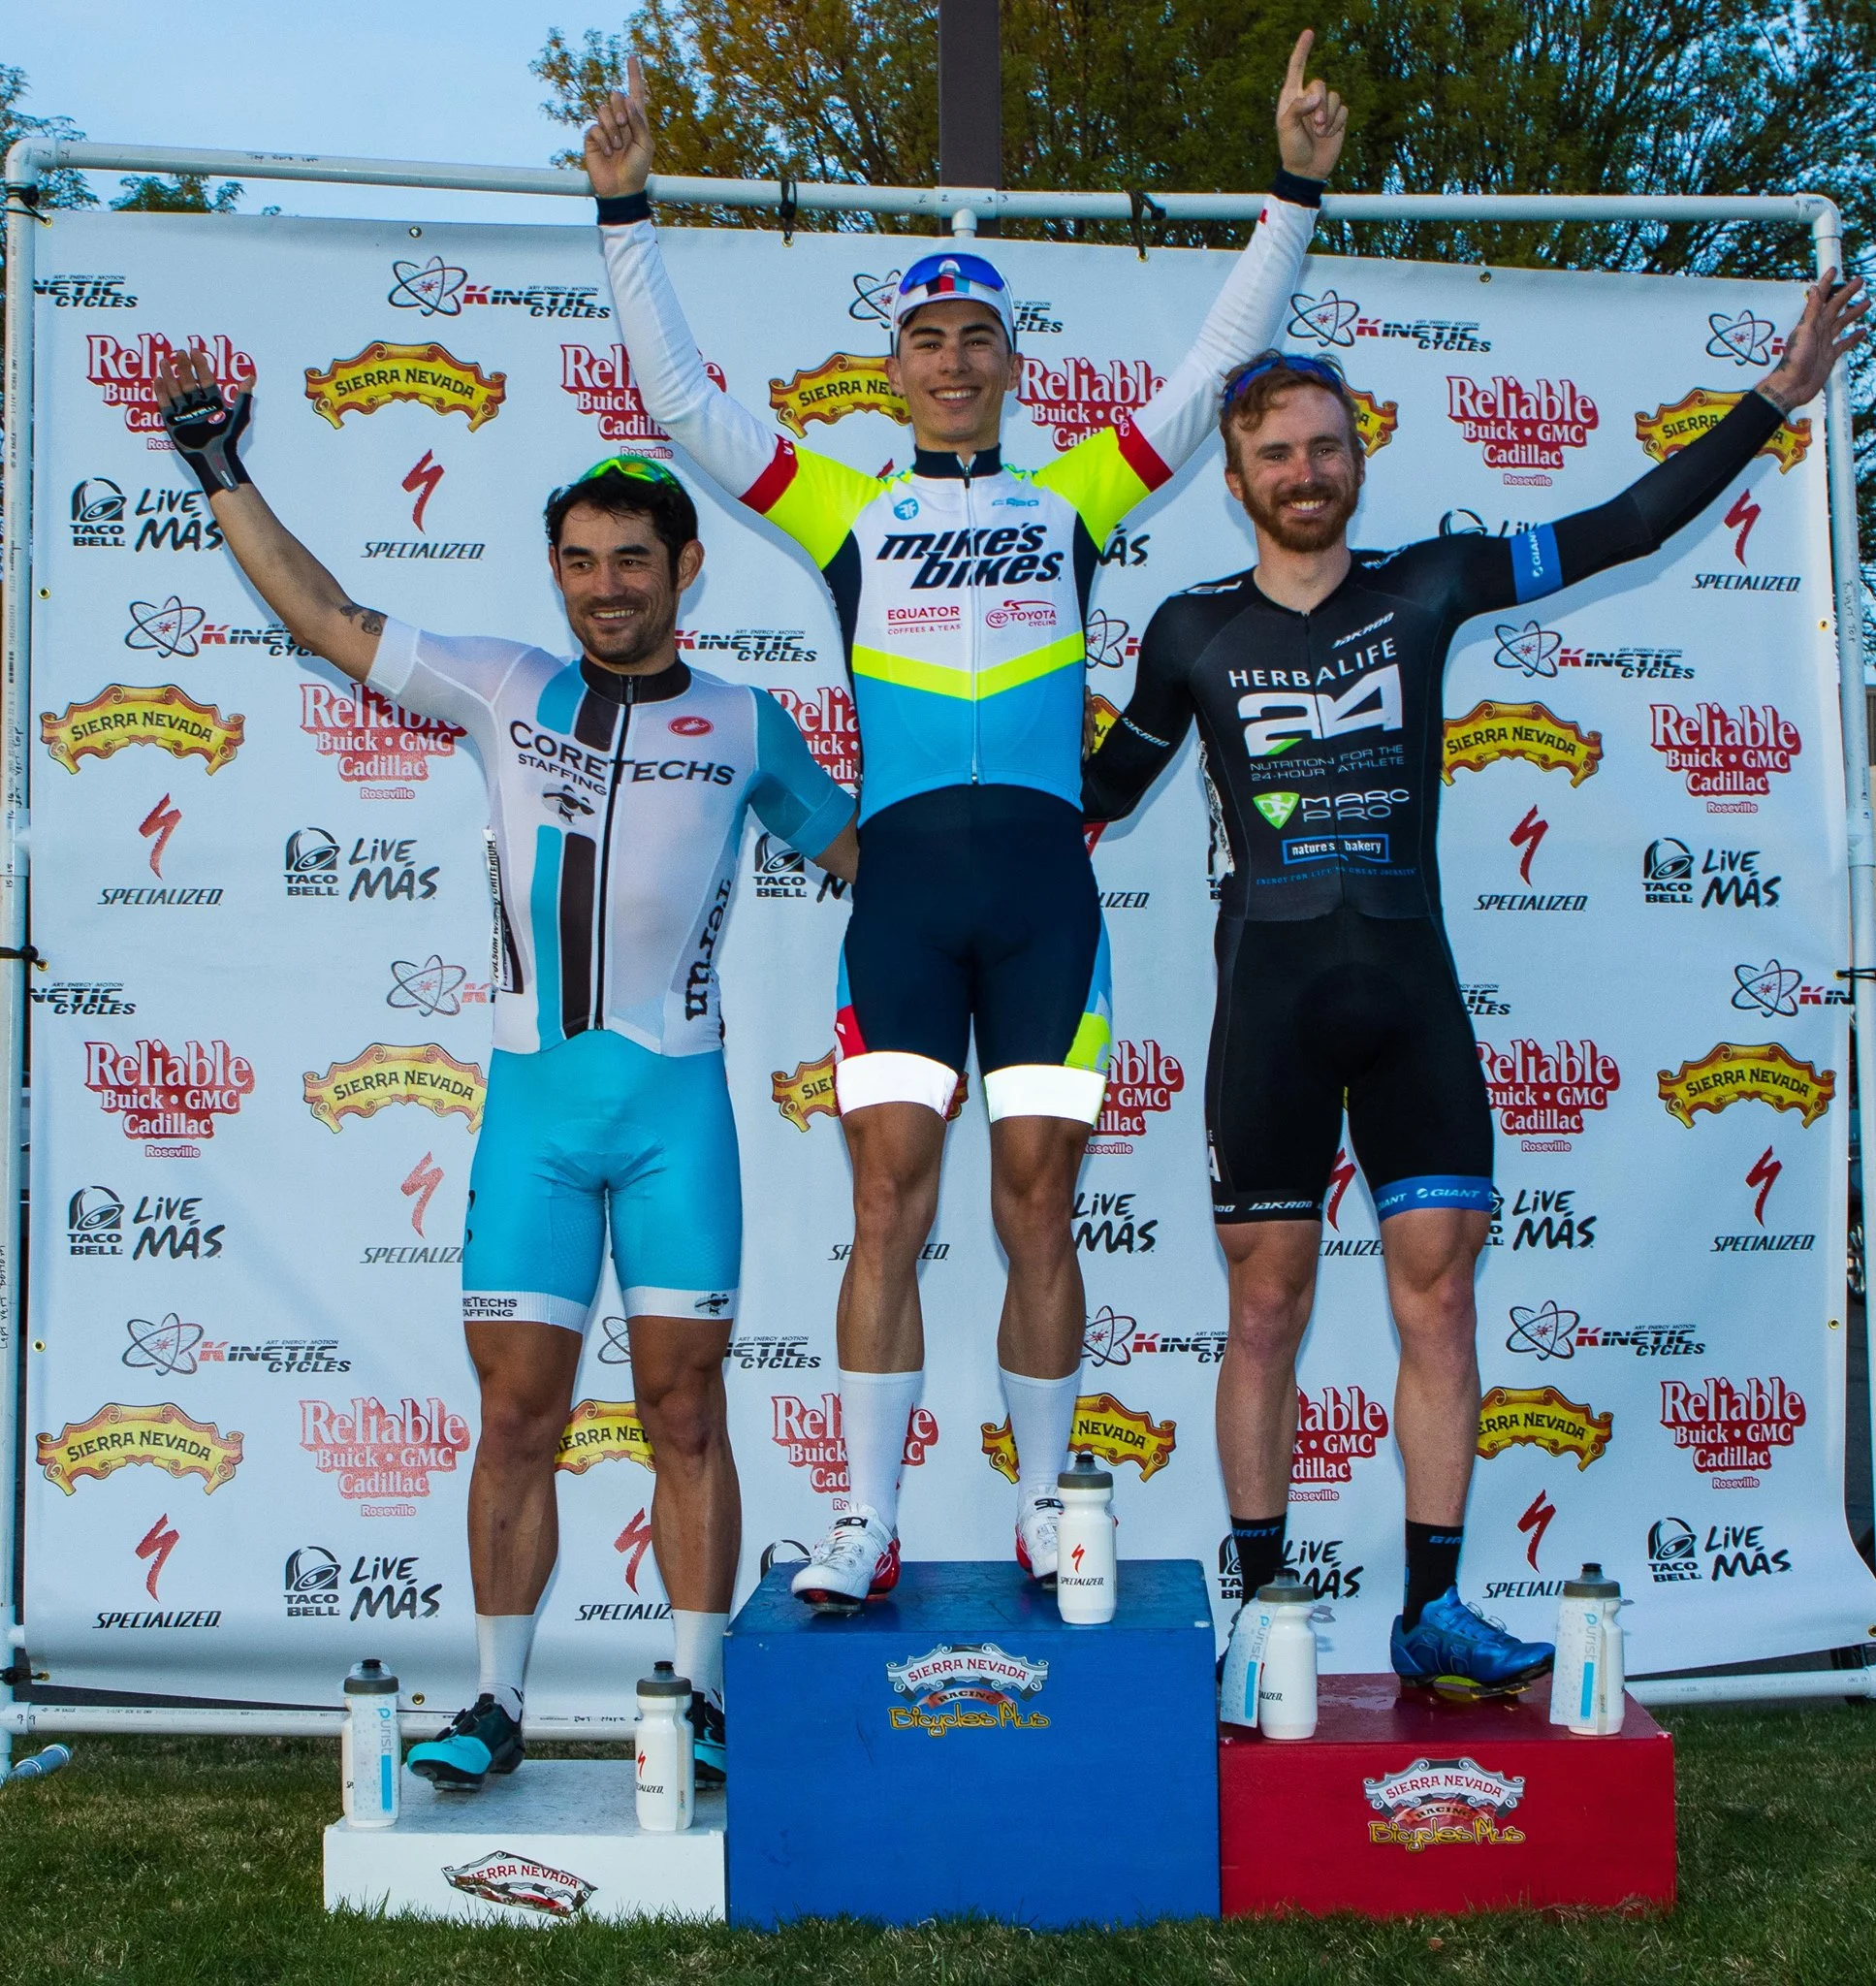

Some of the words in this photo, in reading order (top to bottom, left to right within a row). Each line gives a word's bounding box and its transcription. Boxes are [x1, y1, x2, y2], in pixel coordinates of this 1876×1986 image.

[55, 296, 138, 307] CYCLES
[462, 286, 598, 307] KINETIC
[530, 306, 610, 318] CYCLES
[1356, 318, 1479, 340] KINETIC
[1417, 339, 1491, 352] CYCLES
[335, 368, 400, 397] SIERRA
[405, 368, 476, 400] NEVADA
[798, 379, 862, 407] SIERRA
[577, 391, 638, 412] Buick
[1447, 376, 1598, 425] Reliable
[1033, 403, 1091, 424] Buick
[1463, 421, 1519, 441] Buick
[1536, 424, 1585, 444] GMC
[1482, 444, 1563, 467] Cadillac
[1503, 473, 1553, 487] Roseville
[70, 525, 124, 535] TACO
[73, 536, 126, 548] BELL
[360, 542, 484, 561] SPECIALIZED
[1692, 573, 1801, 593] SPECIALIZED
[887, 605, 960, 621] EQUATOR
[1009, 609, 1057, 622] TOYOTA
[887, 625, 927, 635] COFFEES
[938, 623, 962, 632] TEAS
[737, 650, 817, 662] CYCLES
[1228, 637, 1398, 689] HERBALIFE
[1558, 648, 1682, 668] KINETIC
[1620, 667, 1696, 679] CYCLES
[1236, 663, 1404, 758] 24
[70, 712, 139, 743] SIERRA
[143, 710, 213, 743] NEVADA
[1650, 701, 1801, 752] Reliable
[316, 731, 379, 752] Buick
[398, 732, 455, 753] GMC
[1446, 726, 1508, 755] SIERRA
[1511, 725, 1577, 757] NEVADA
[337, 756, 429, 780] Cadillac
[1249, 756, 1335, 772] NUTRITION
[1339, 747, 1374, 764] FOR
[1376, 744, 1405, 755] THE
[1666, 749, 1724, 769] Buick
[1741, 750, 1790, 771] GMC
[518, 753, 609, 797] STAFFING
[1250, 768, 1326, 783] 24-HOUR
[1336, 755, 1406, 775] ATHLETE
[360, 786, 416, 801] Roseville
[1685, 772, 1770, 795] Cadillac
[1301, 787, 1411, 809] MARC
[1706, 800, 1759, 814] Roseville
[1302, 803, 1393, 823] PRO
[1290, 840, 1336, 857] nature's
[1344, 839, 1383, 855] bakery
[284, 874, 338, 885] TACO
[752, 875, 807, 886] TACO
[1642, 882, 1692, 893] TACO
[97, 887, 224, 906] SPECIALIZED
[287, 885, 338, 897] BELL
[756, 887, 807, 898] BELL
[1645, 893, 1693, 904] BELL
[1473, 894, 1588, 912] SPECIALIZED
[54, 1003, 137, 1015] CYCLES
[84, 1039, 255, 1091] Reliable
[334, 1073, 400, 1102] SIERRA
[403, 1070, 474, 1103] NEVADA
[1685, 1068, 1746, 1099] SIERRA
[1748, 1067, 1811, 1099] NEVADA
[102, 1091, 164, 1110] Buick
[184, 1091, 239, 1111] GMC
[1118, 1087, 1170, 1107] GMC
[1556, 1087, 1605, 1107] GMC
[123, 1114, 213, 1137] Cadillac
[1500, 1109, 1583, 1134] Cadillac
[144, 1144, 201, 1159] Roseville
[1521, 1139, 1573, 1153] Roseville
[1429, 1188, 1481, 1199] GIANT
[67, 1233, 122, 1244] TACO
[1709, 1233, 1817, 1252] SPECIALIZED
[71, 1245, 123, 1256] BELL
[461, 1296, 518, 1308] RETECHS
[462, 1308, 515, 1318] AFFING
[1574, 1327, 1696, 1346] KINETIC
[199, 1341, 338, 1362] KINETIC
[1637, 1342, 1705, 1357] CYCLES
[268, 1360, 352, 1373] CYCLES
[741, 1356, 822, 1370] CYCLES
[1661, 1376, 1806, 1425] Reliable
[299, 1396, 471, 1448] Reliable
[1523, 1410, 1589, 1440] NEVADA
[1077, 1419, 1148, 1452] NEVADA
[1322, 1434, 1376, 1455] GMC
[1674, 1425, 1729, 1445] Buick
[1745, 1425, 1792, 1445] GMC
[68, 1430, 137, 1463] SIERRA
[140, 1429, 212, 1463] NEVADA
[316, 1448, 377, 1469] Buick
[399, 1448, 454, 1469] GMC
[1693, 1448, 1771, 1471] Cadillac
[337, 1472, 430, 1496] Cadillac
[1711, 1476, 1761, 1490] Roseville
[1288, 1489, 1340, 1501] Roseville
[361, 1503, 417, 1517] Roseville
[1648, 1562, 1700, 1573] TACO
[1059, 1576, 1105, 1587] SPECIALIZED
[1653, 1573, 1702, 1584] BELL
[283, 1593, 339, 1605] TACO
[92, 1610, 222, 1630] SPECIALIZED
[287, 1605, 340, 1618] BELL
[907, 1658, 964, 1683] SIERRA
[967, 1657, 1028, 1682] NEVADA
[938, 1690, 995, 1704] RACING
[888, 1702, 998, 1739] Bicycles
[997, 1700, 1051, 1729] Plus
[1385, 1775, 1441, 1800] SIERRA
[1444, 1774, 1504, 1798] NEVADA
[1415, 1805, 1473, 1819] RACING
[1368, 1817, 1475, 1853] Bicycles
[1473, 1815, 1527, 1844] Plus
[521, 1864, 580, 1889] NEVADA
